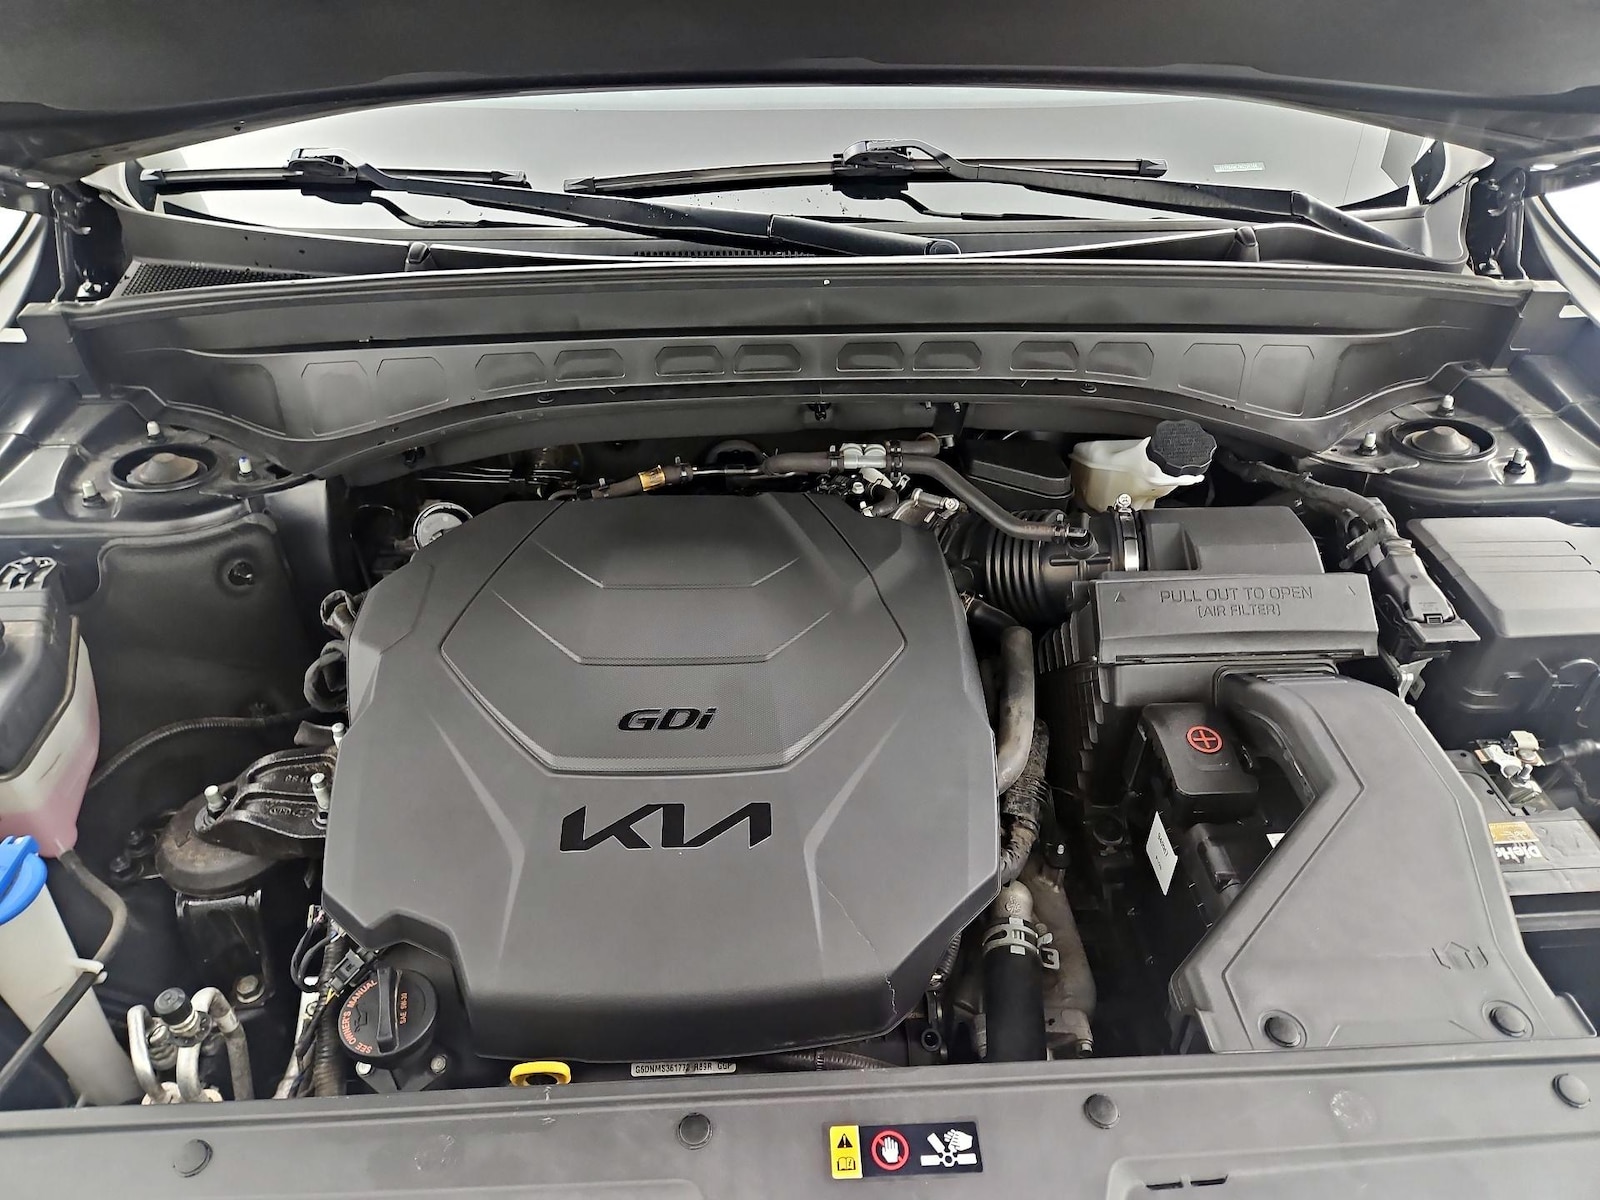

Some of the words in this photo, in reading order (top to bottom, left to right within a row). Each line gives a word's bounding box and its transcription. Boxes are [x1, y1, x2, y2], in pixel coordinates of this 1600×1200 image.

[1160, 589, 1203, 603] PULL
[1206, 587, 1239, 602] OUT
[1245, 587, 1265, 600] TO
[1269, 586, 1313, 600] OPEN
[1230, 603, 1281, 617] FILTER)
[618, 707, 717, 731] GDi
[560, 802, 772, 853] KIA
[346, 980, 378, 1009] MANUAL
[355, 1042, 373, 1054] SEE
